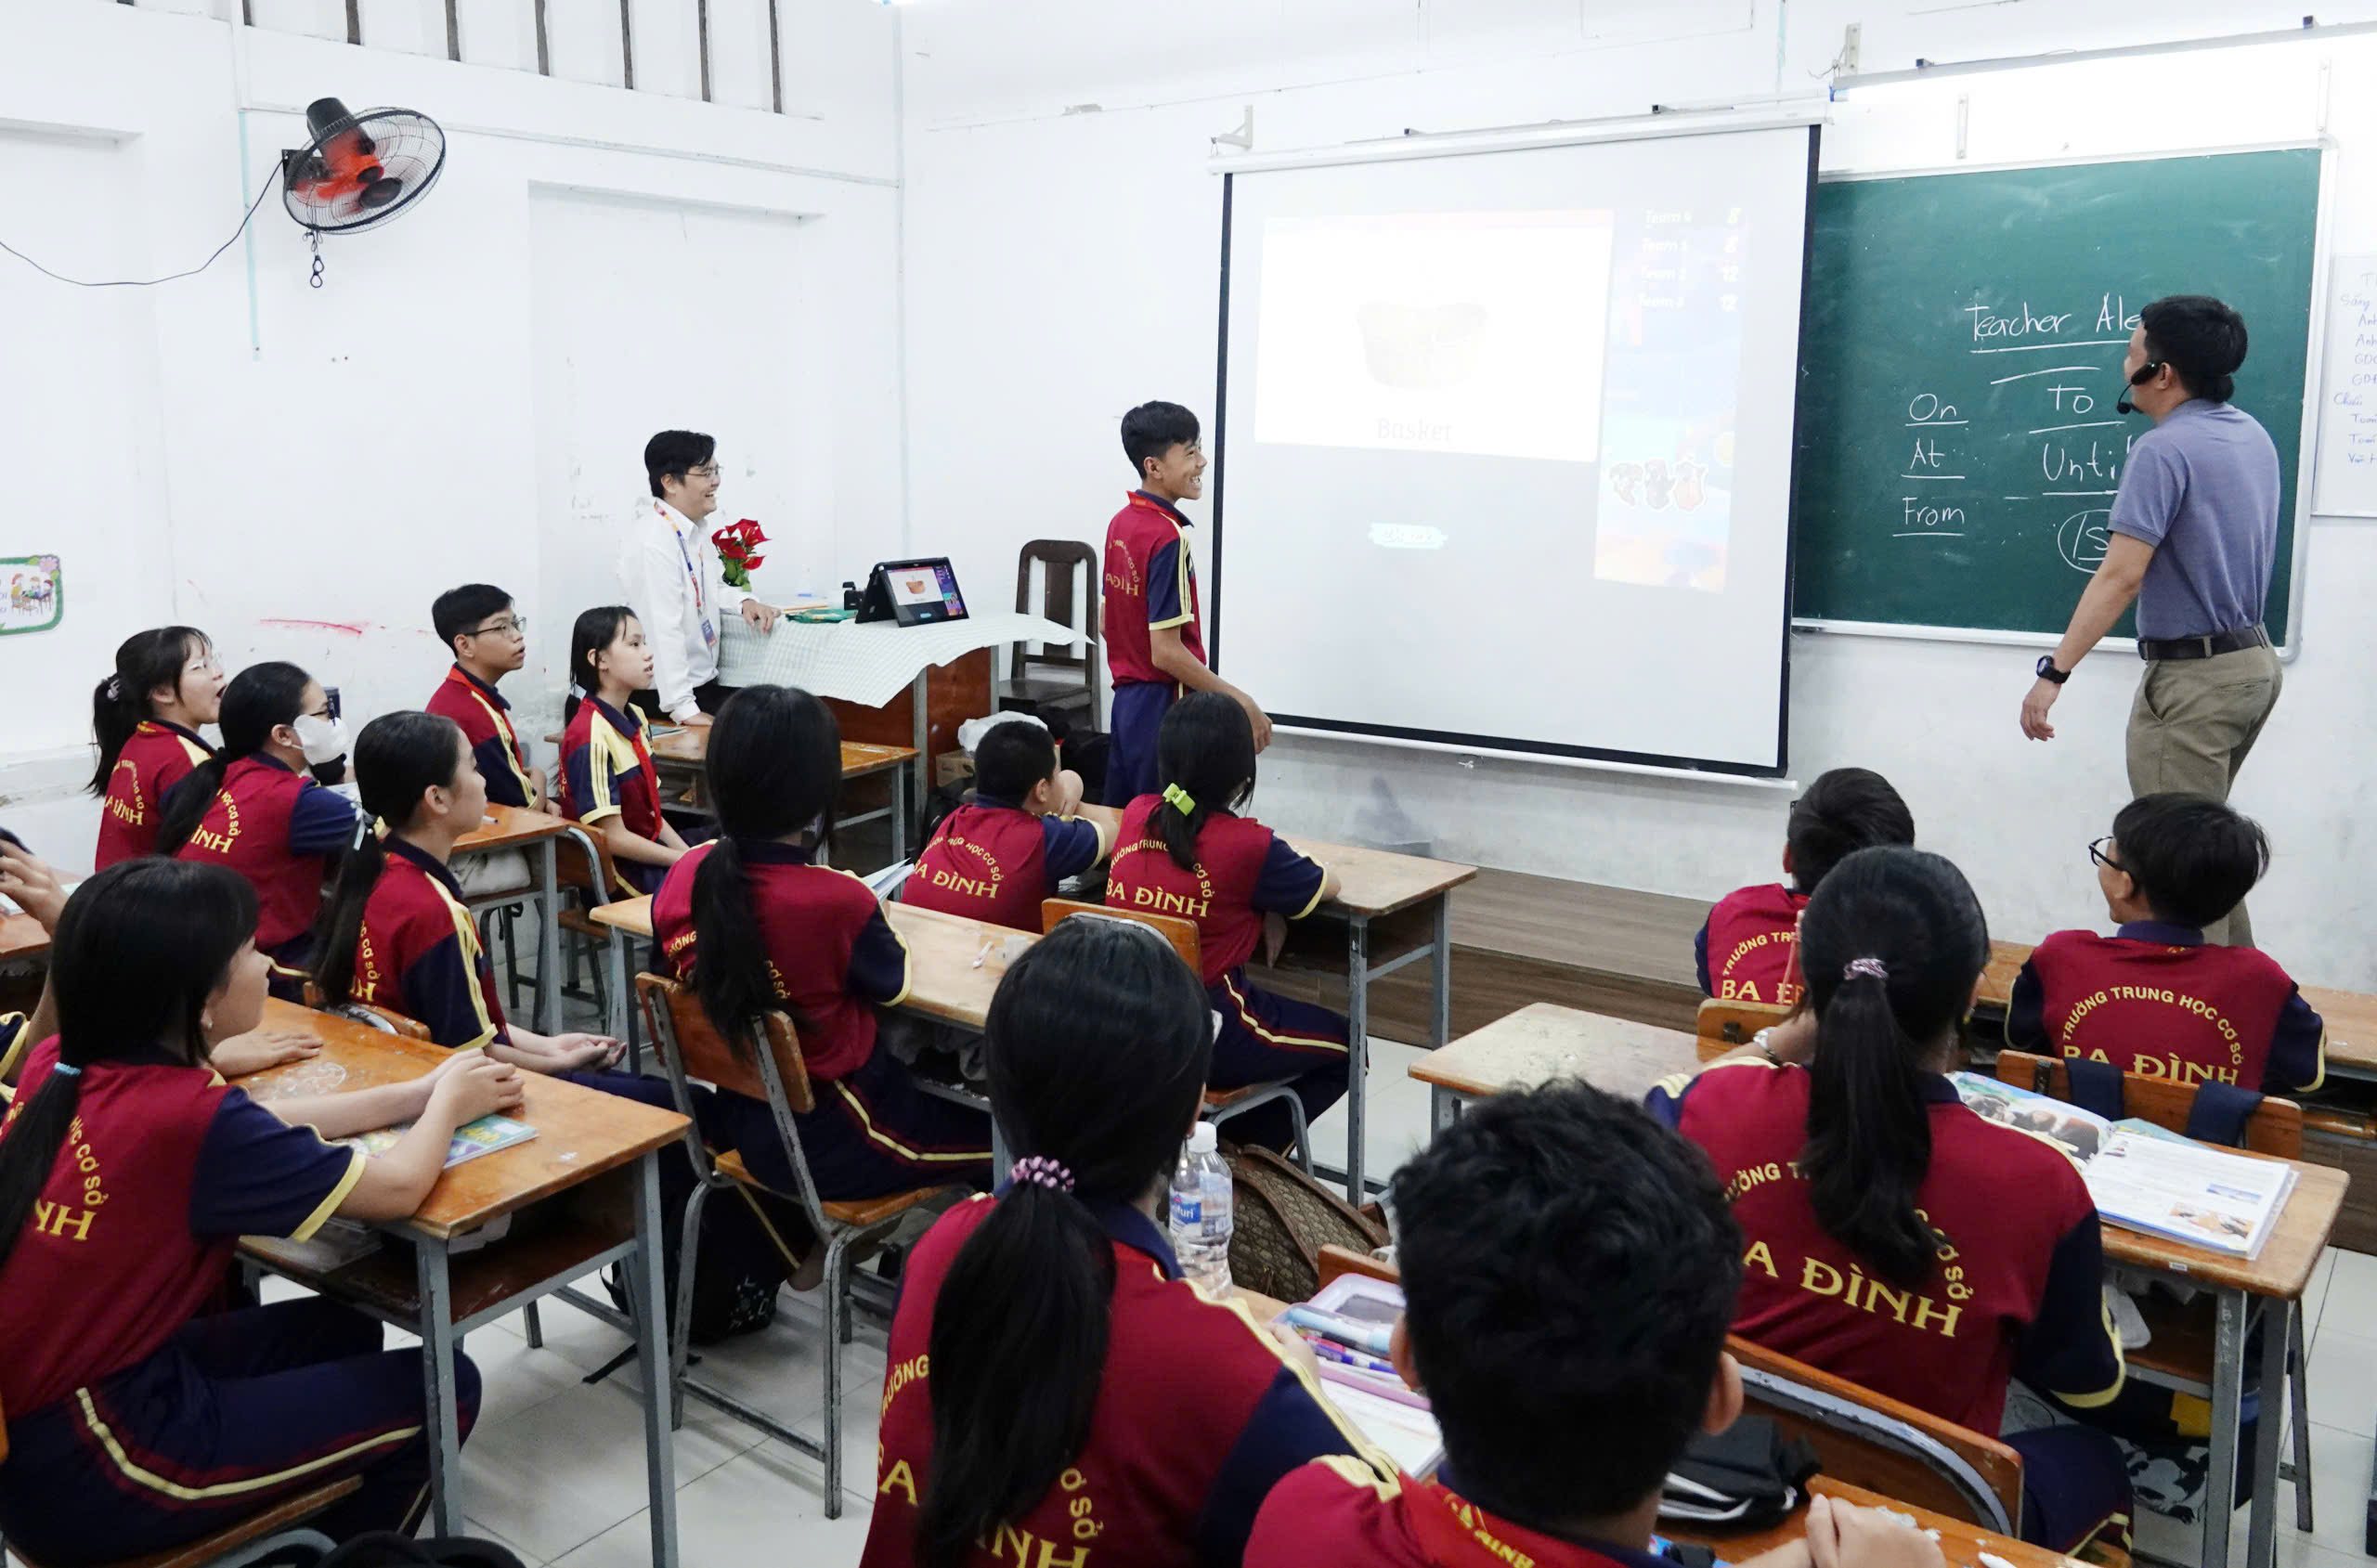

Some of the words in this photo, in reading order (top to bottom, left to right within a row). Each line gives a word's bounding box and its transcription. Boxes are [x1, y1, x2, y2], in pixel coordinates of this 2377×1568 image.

[1965, 302, 2072, 342] Teacher
[2096, 292, 2142, 333] Ale
[1908, 393, 1958, 421] On
[2046, 383, 2095, 414] To
[1374, 417, 1452, 441] Basket
[1909, 439, 1946, 470] At
[1901, 496, 1966, 525] From
[189, 823, 235, 854] ÌNH
[931, 870, 999, 900] ĐÌNH
[1134, 886, 1210, 917] ĐÌNH
[1721, 979, 1761, 1003] BA
[2062, 991, 2109, 1042] TRƯỜNG
[2110, 986, 2175, 1004] TRUNG
[2178, 993, 2218, 1021] HỌC
[2216, 1017, 2239, 1041] CƠ
[2229, 1041, 2245, 1066] SỞ
[2132, 1052, 2240, 1087] ĐÌNH
[33, 1197, 97, 1242] NH
[1742, 1239, 1780, 1279] A
[1799, 1255, 1964, 1338] ĐÌNH
[1059, 1468, 1087, 1492] Ơ
[986, 1518, 1091, 1568] NH
